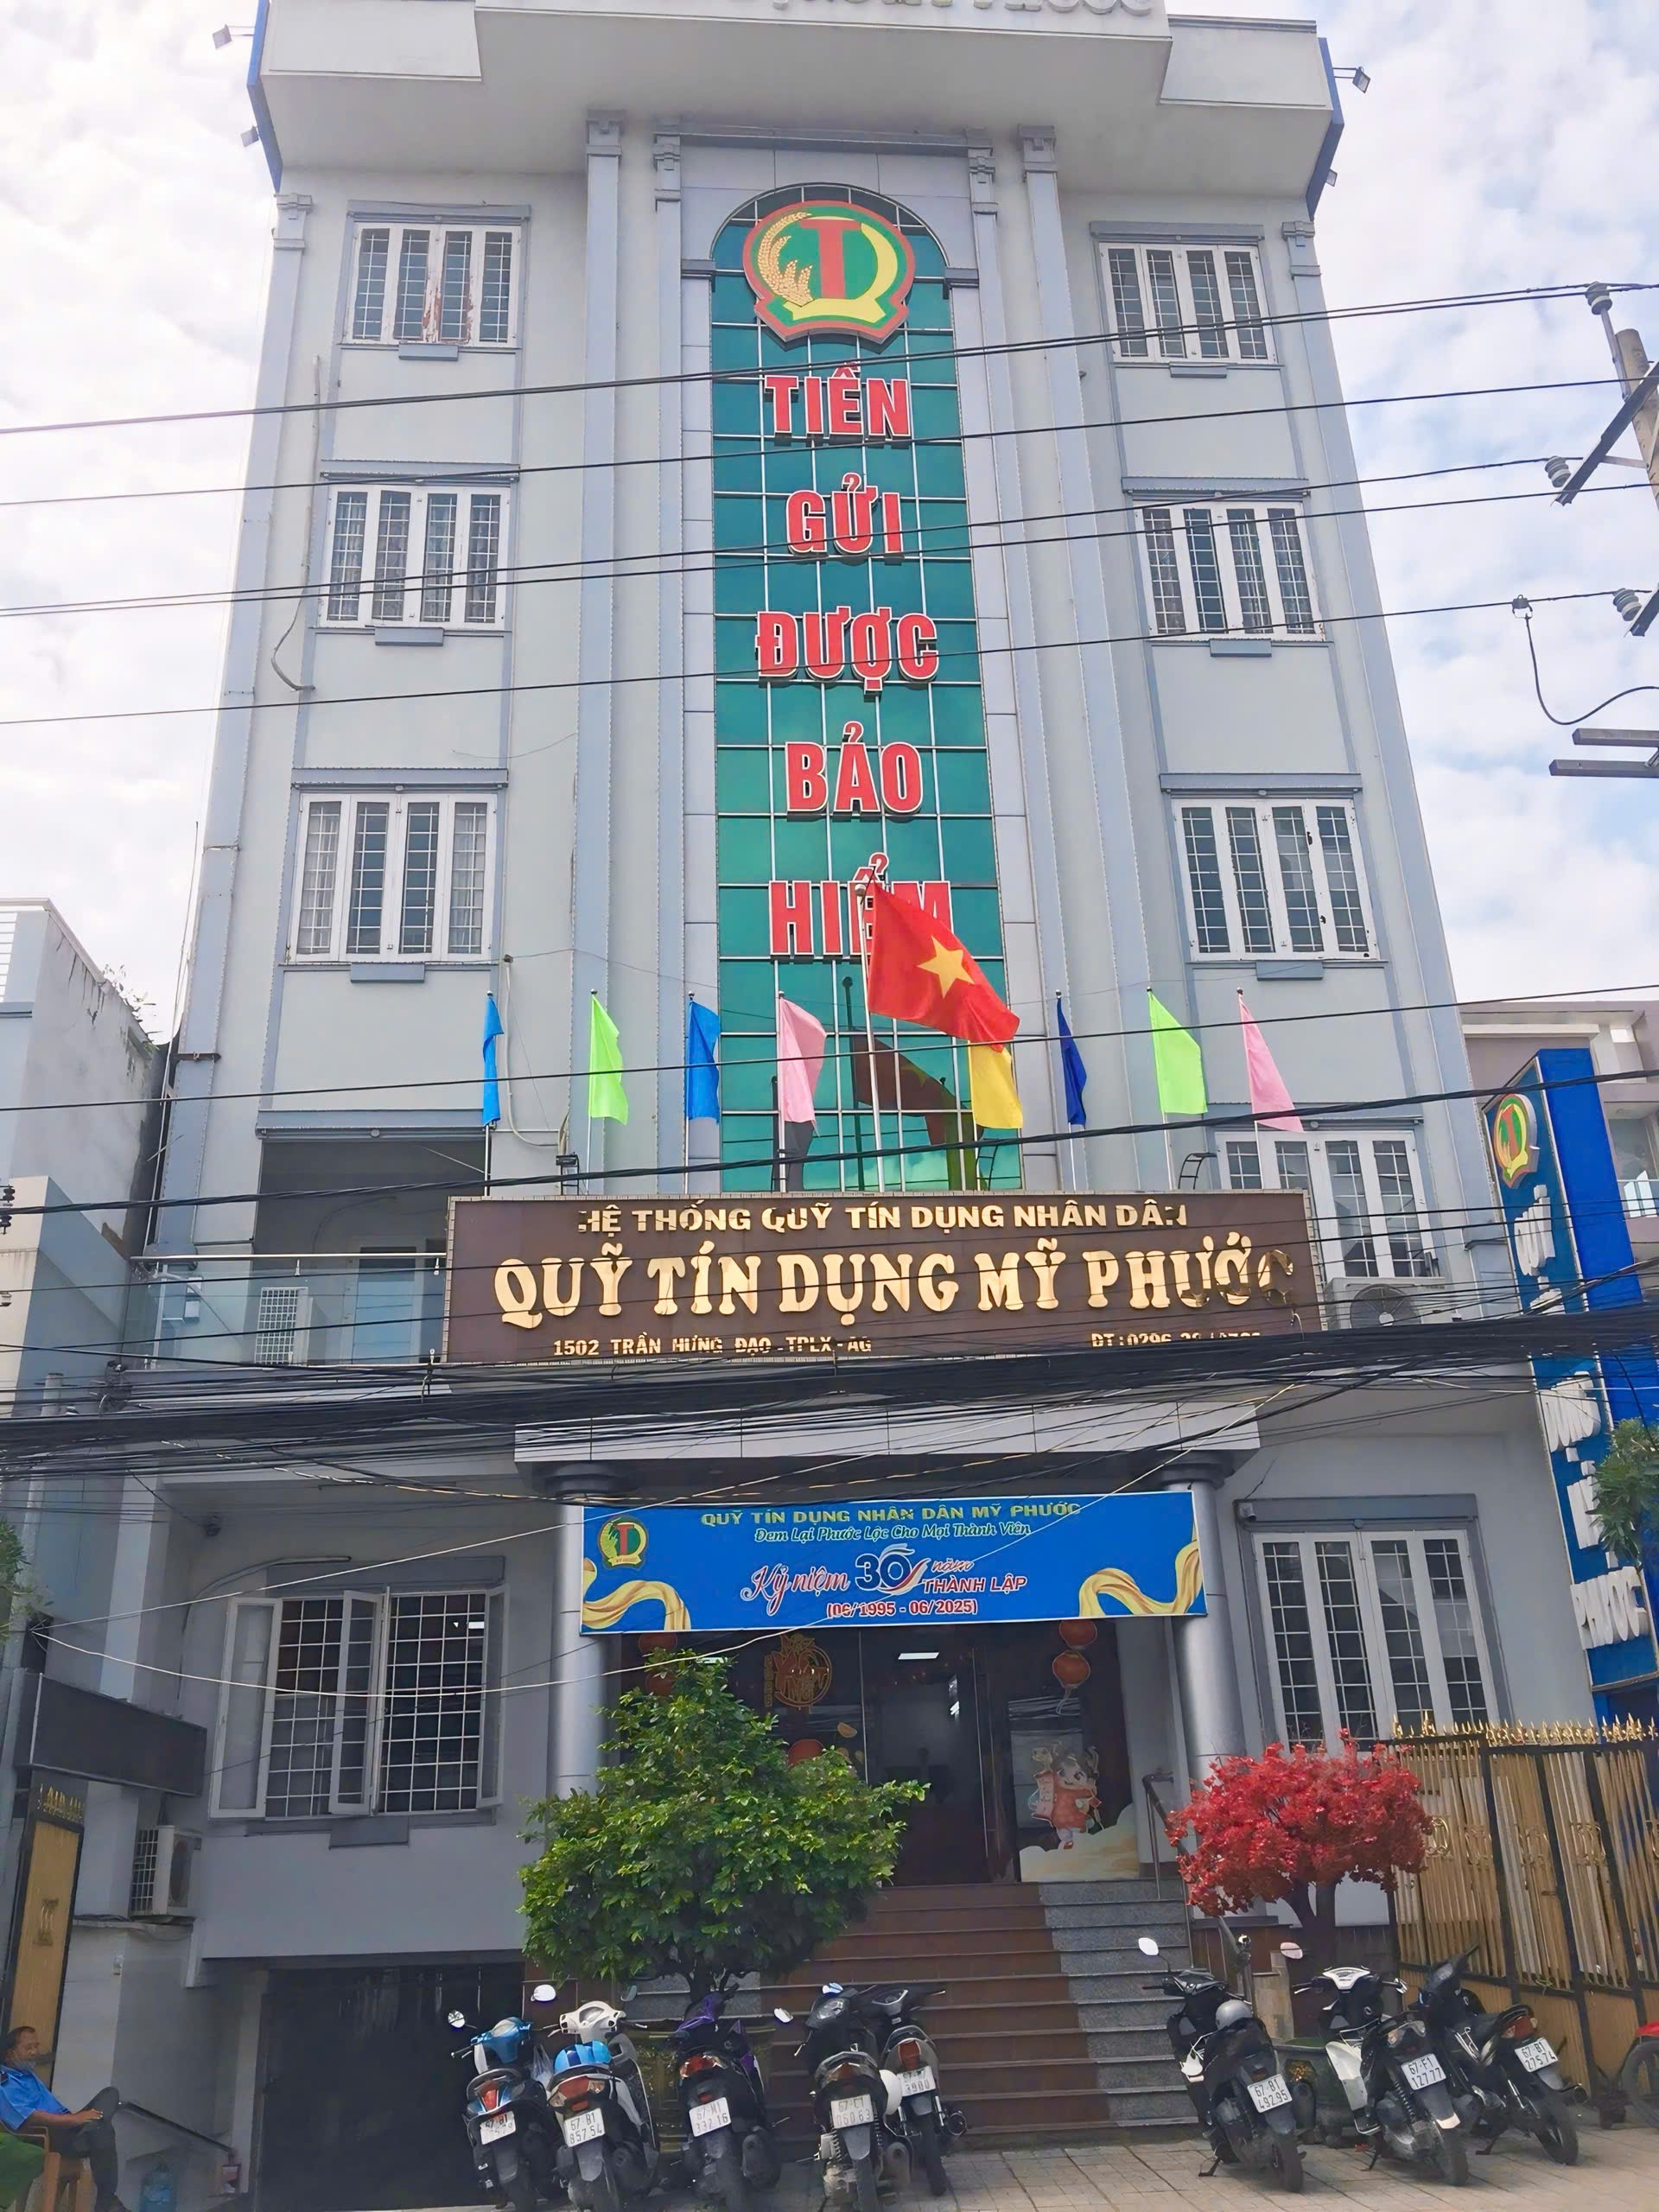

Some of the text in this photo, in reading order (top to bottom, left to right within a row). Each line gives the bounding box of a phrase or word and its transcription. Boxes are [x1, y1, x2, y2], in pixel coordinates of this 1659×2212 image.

[765, 362, 911, 436] TIỀN
[785, 472, 904, 554] GỬI
[755, 606, 939, 691] ĐƯỢC
[785, 721, 924, 813] BẢO
[632, 1199, 751, 1232] THỐNG
[761, 1203, 832, 1234] QUỸ
[845, 1201, 900, 1230] TÍN
[911, 1205, 1005, 1234] DỤNG
[1014, 1199, 1108, 1229] NHÂN
[494, 1242, 633, 1330] QUỸ
[646, 1240, 762, 1316] TÍN
[777, 1251, 959, 1326] DỤNG
[974, 1237, 1067, 1312] MỸ
[553, 1339, 600, 1357] 1502
[610, 1331, 662, 1355] TRẦN
[734, 1337, 772, 1356] ĐẠO
[701, 1501, 1081, 1527] QUỸ TÍN DỤNG NHÂN DÂN MỸ PHƯỚC
[754, 1521, 1031, 1544] Đem Lại Phước Lộc Cho Mọi Thành Viên
[791, 1567, 851, 1596] niệm
[855, 1549, 916, 1594] 30
[922, 1574, 1028, 1595] THÀNH LẬP
[827, 1602, 896, 1620] (06/1995
[909, 1599, 978, 1617] 06/2025)
